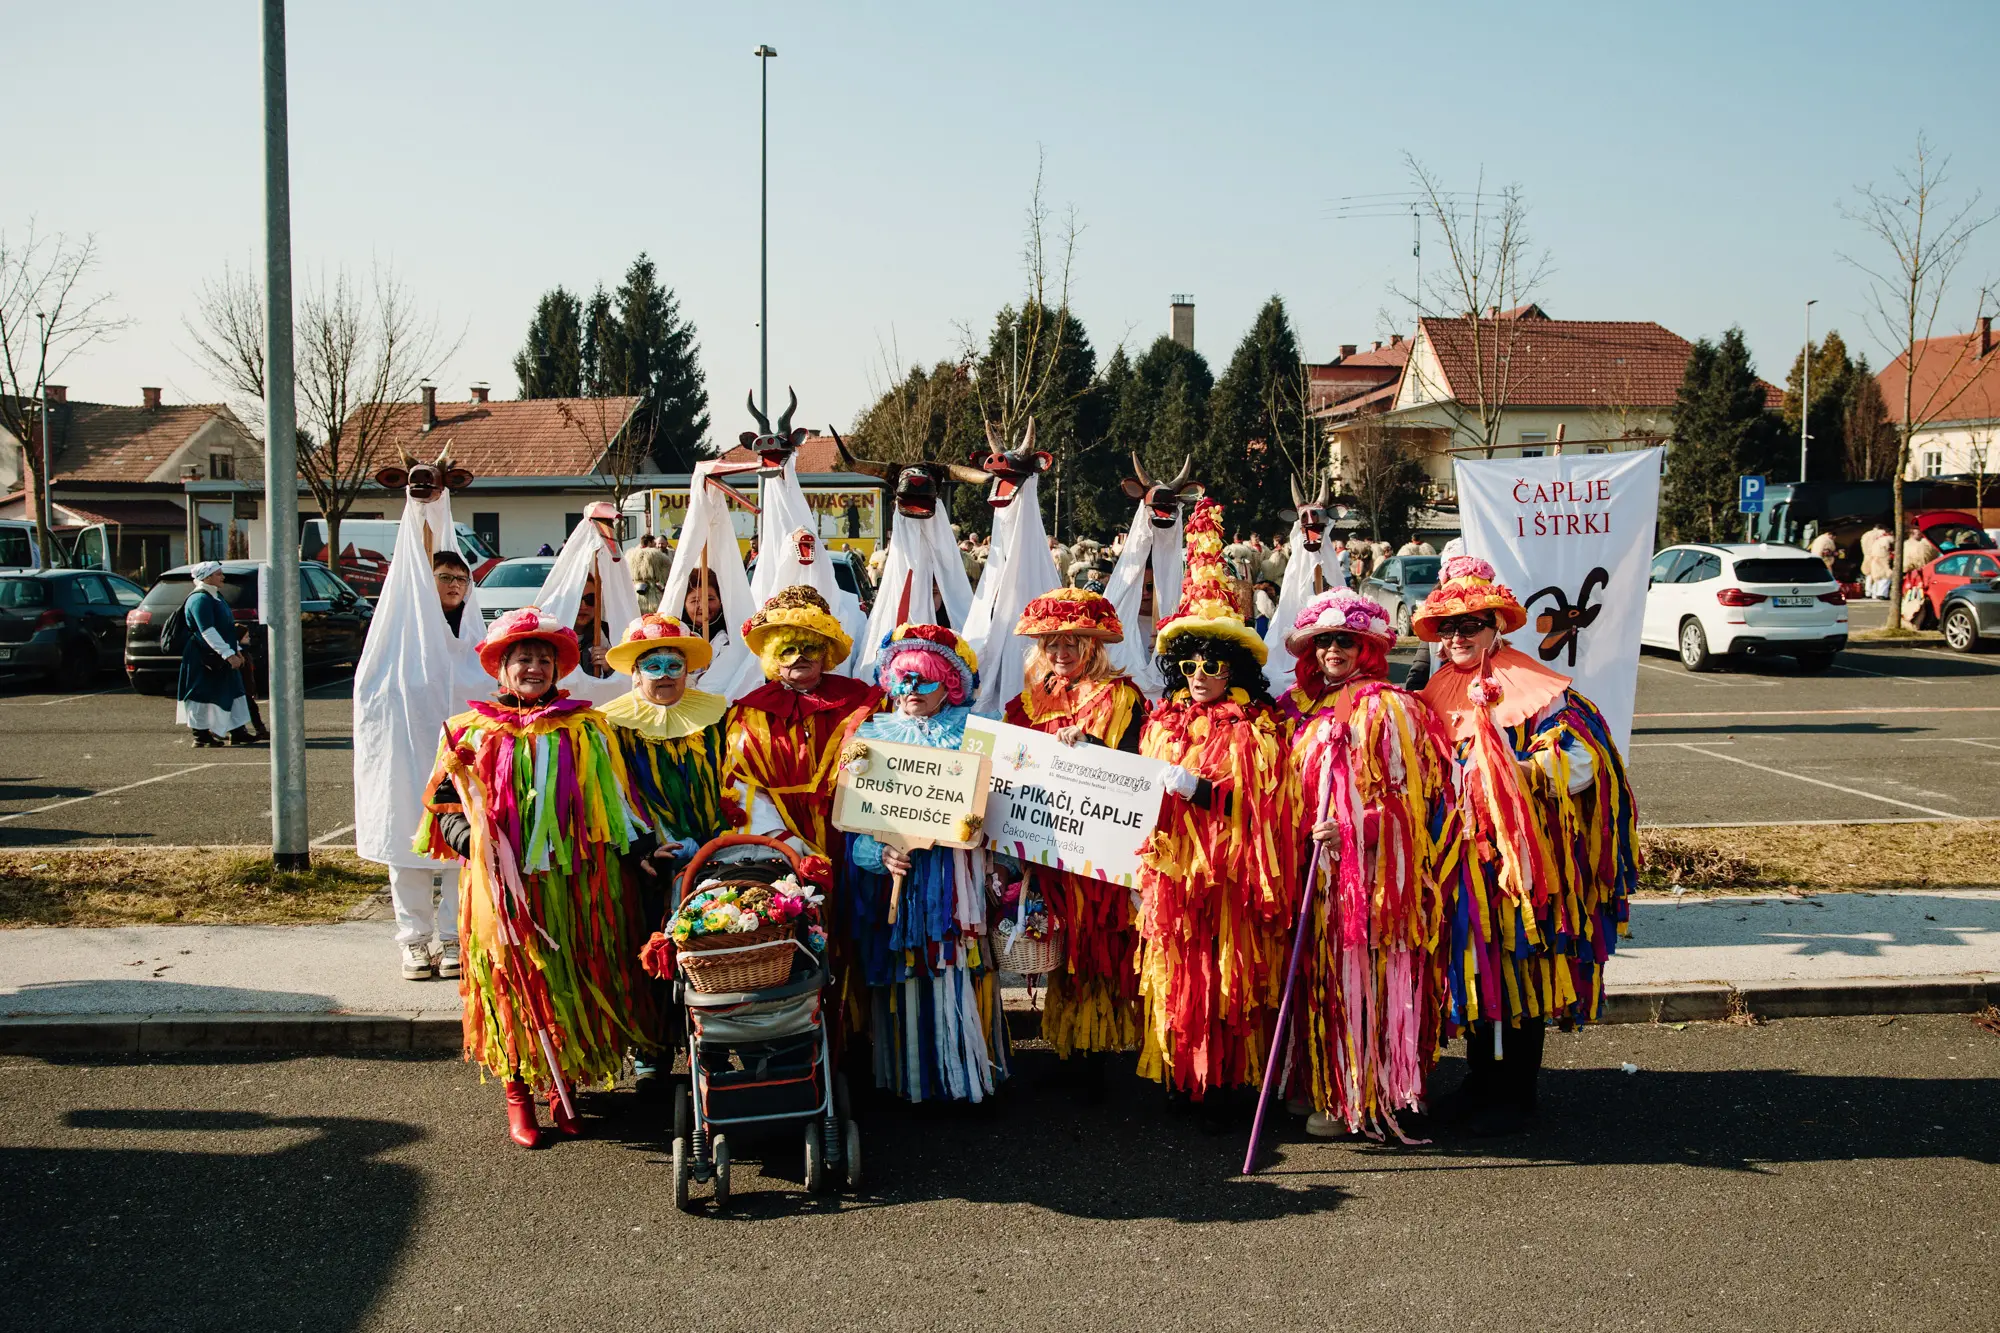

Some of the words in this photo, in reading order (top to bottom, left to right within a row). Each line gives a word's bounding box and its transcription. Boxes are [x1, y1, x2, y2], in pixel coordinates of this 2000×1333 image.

[1512, 478, 1611, 504] ČAPLJE
[1746, 479, 1760, 497] P
[1517, 516, 1526, 538] I
[1534, 511, 1611, 536] ŠTRKI
[886, 756, 942, 776] CIMERI
[855, 777, 923, 797] DRUŠTVO
[926, 785, 965, 804] ŽENA
[861, 801, 876, 814] M.
[880, 803, 952, 825] SREDIŠĆE
[1010, 803, 1027, 821] IN
[1030, 808, 1085, 836] CIMERI
[1020, 784, 1074, 815] PIKAČI,
[1080, 796, 1144, 829] ČAPLJE
